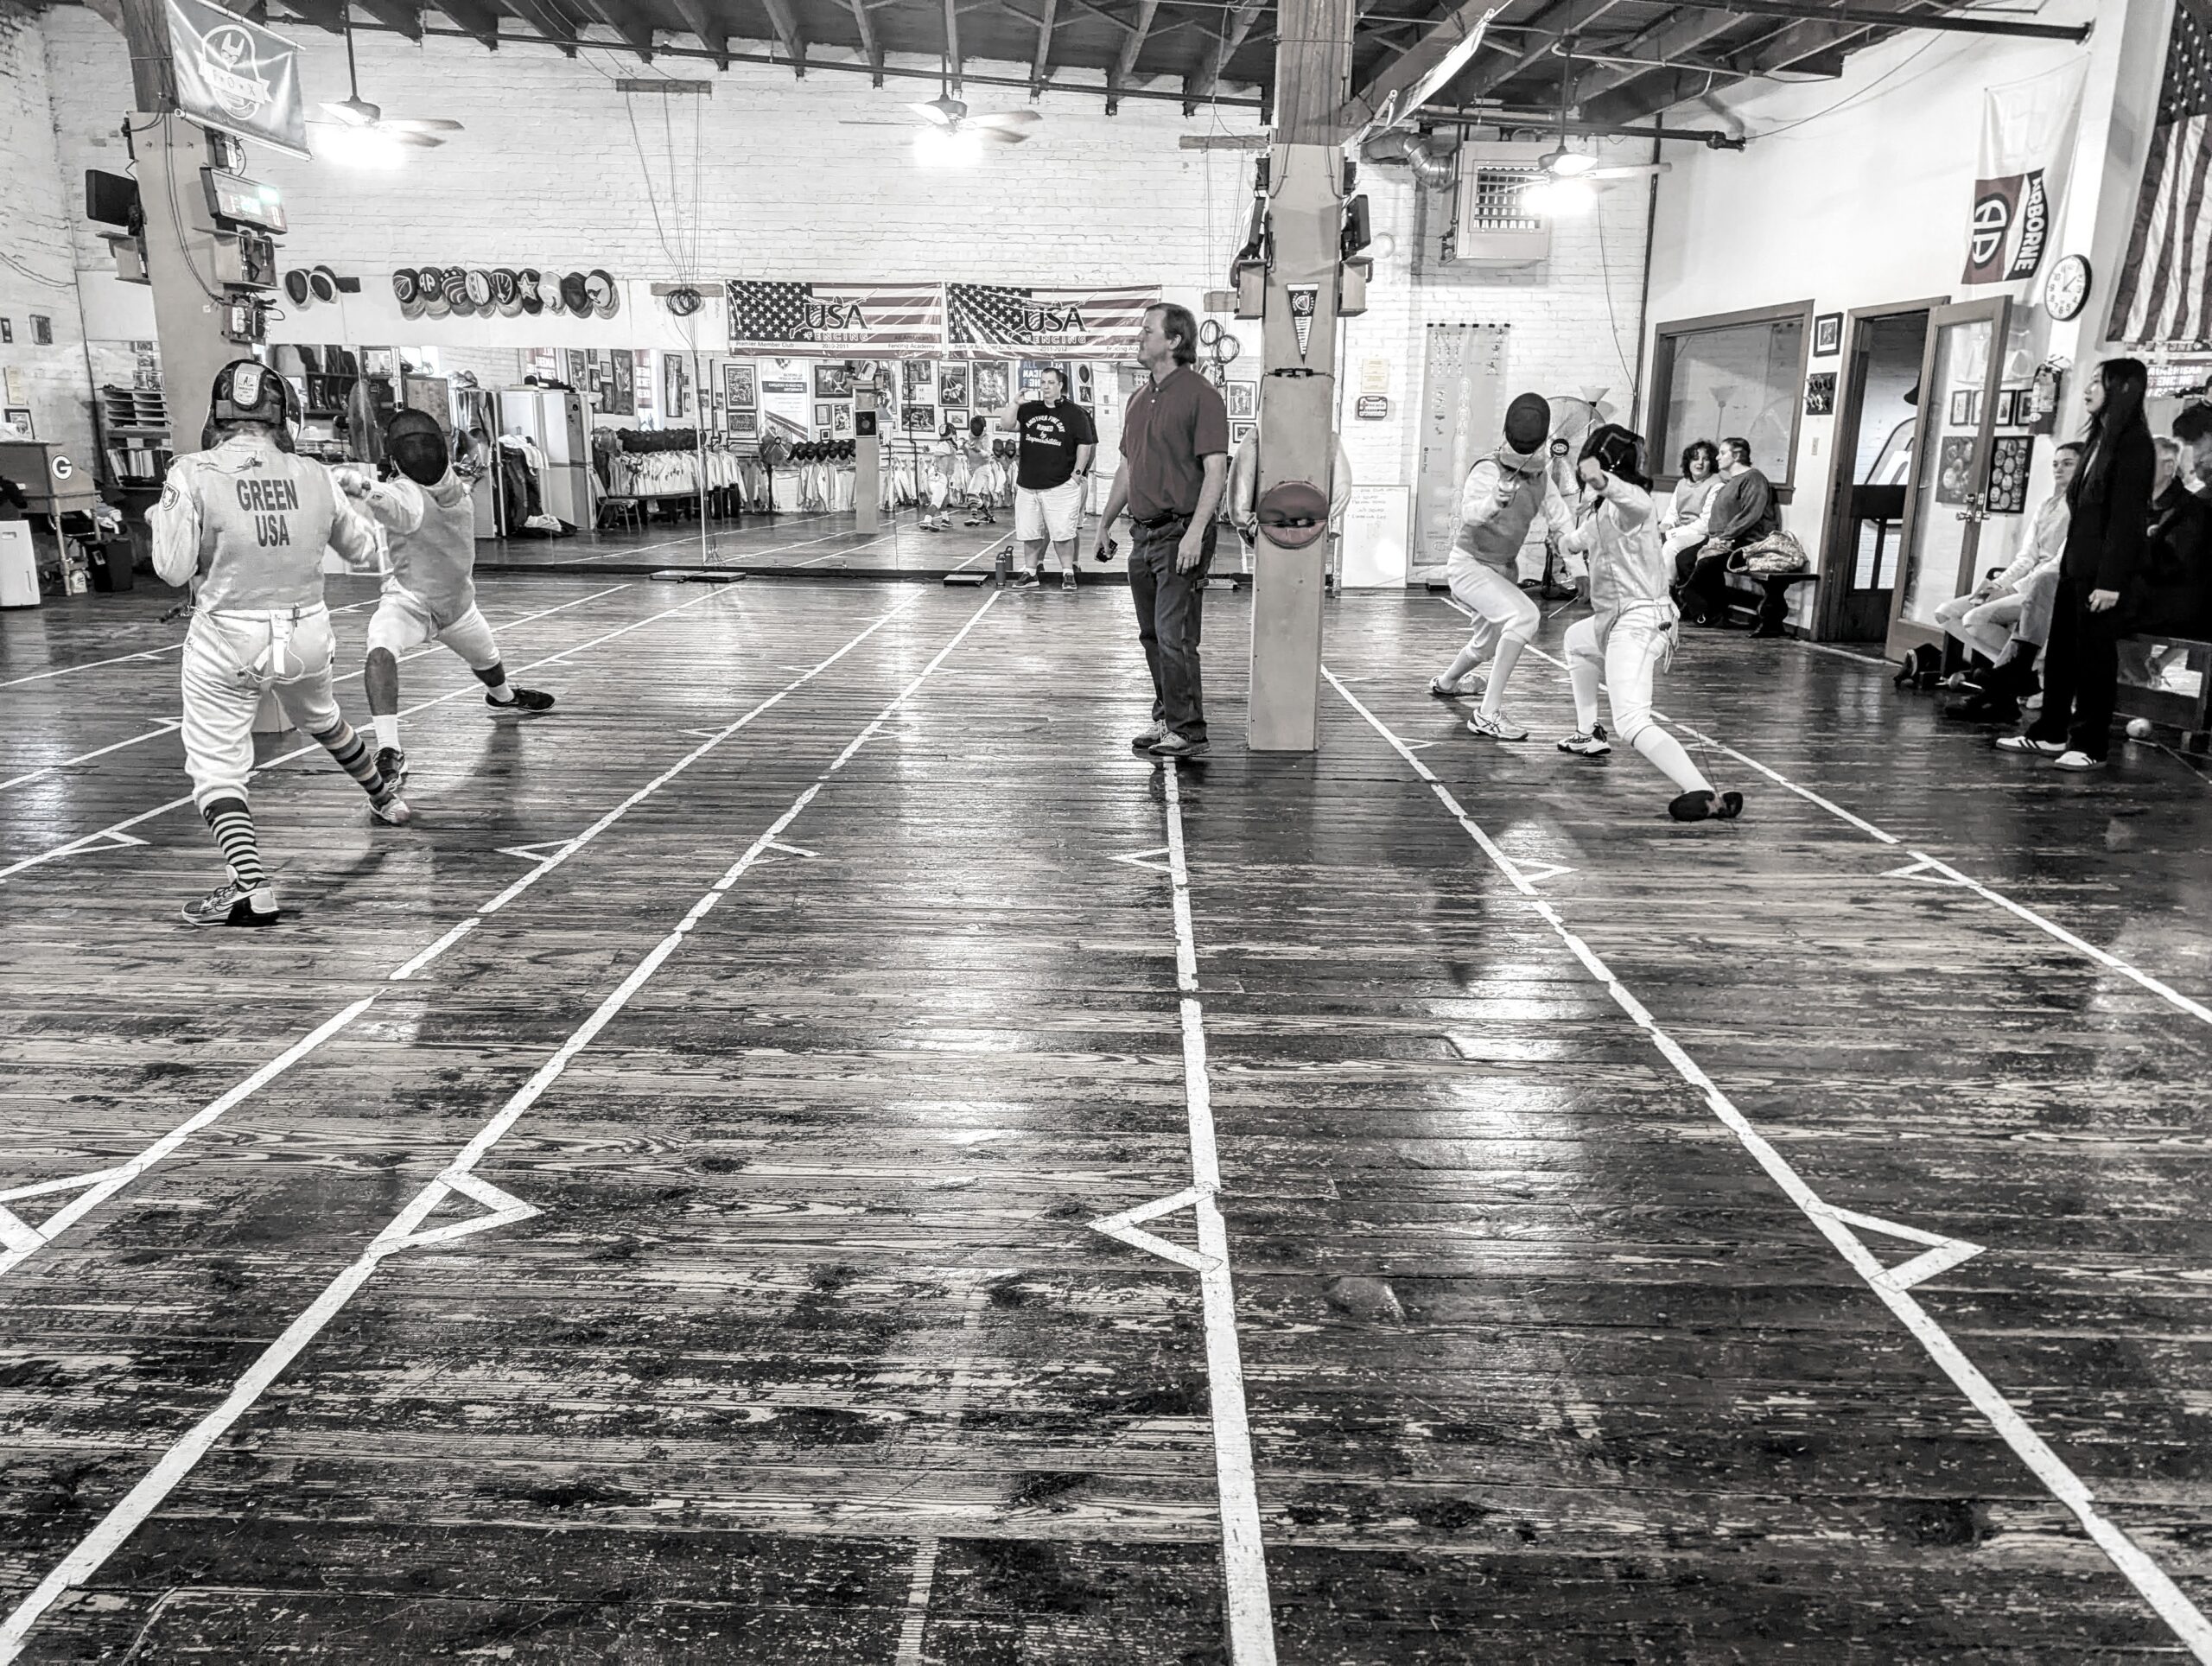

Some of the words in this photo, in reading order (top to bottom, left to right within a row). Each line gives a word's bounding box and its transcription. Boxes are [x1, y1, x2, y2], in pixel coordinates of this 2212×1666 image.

[804, 303, 868, 329] USA
[1022, 306, 1086, 333] USA
[807, 332, 868, 341] FENCING
[1025, 334, 1086, 344] FENCING
[1026, 416, 1048, 428] ANOTHER
[1056, 422, 1065, 433] DAY
[52, 455, 73, 480] G
[236, 479, 299, 512] GREEN
[256, 514, 290, 547] USA
